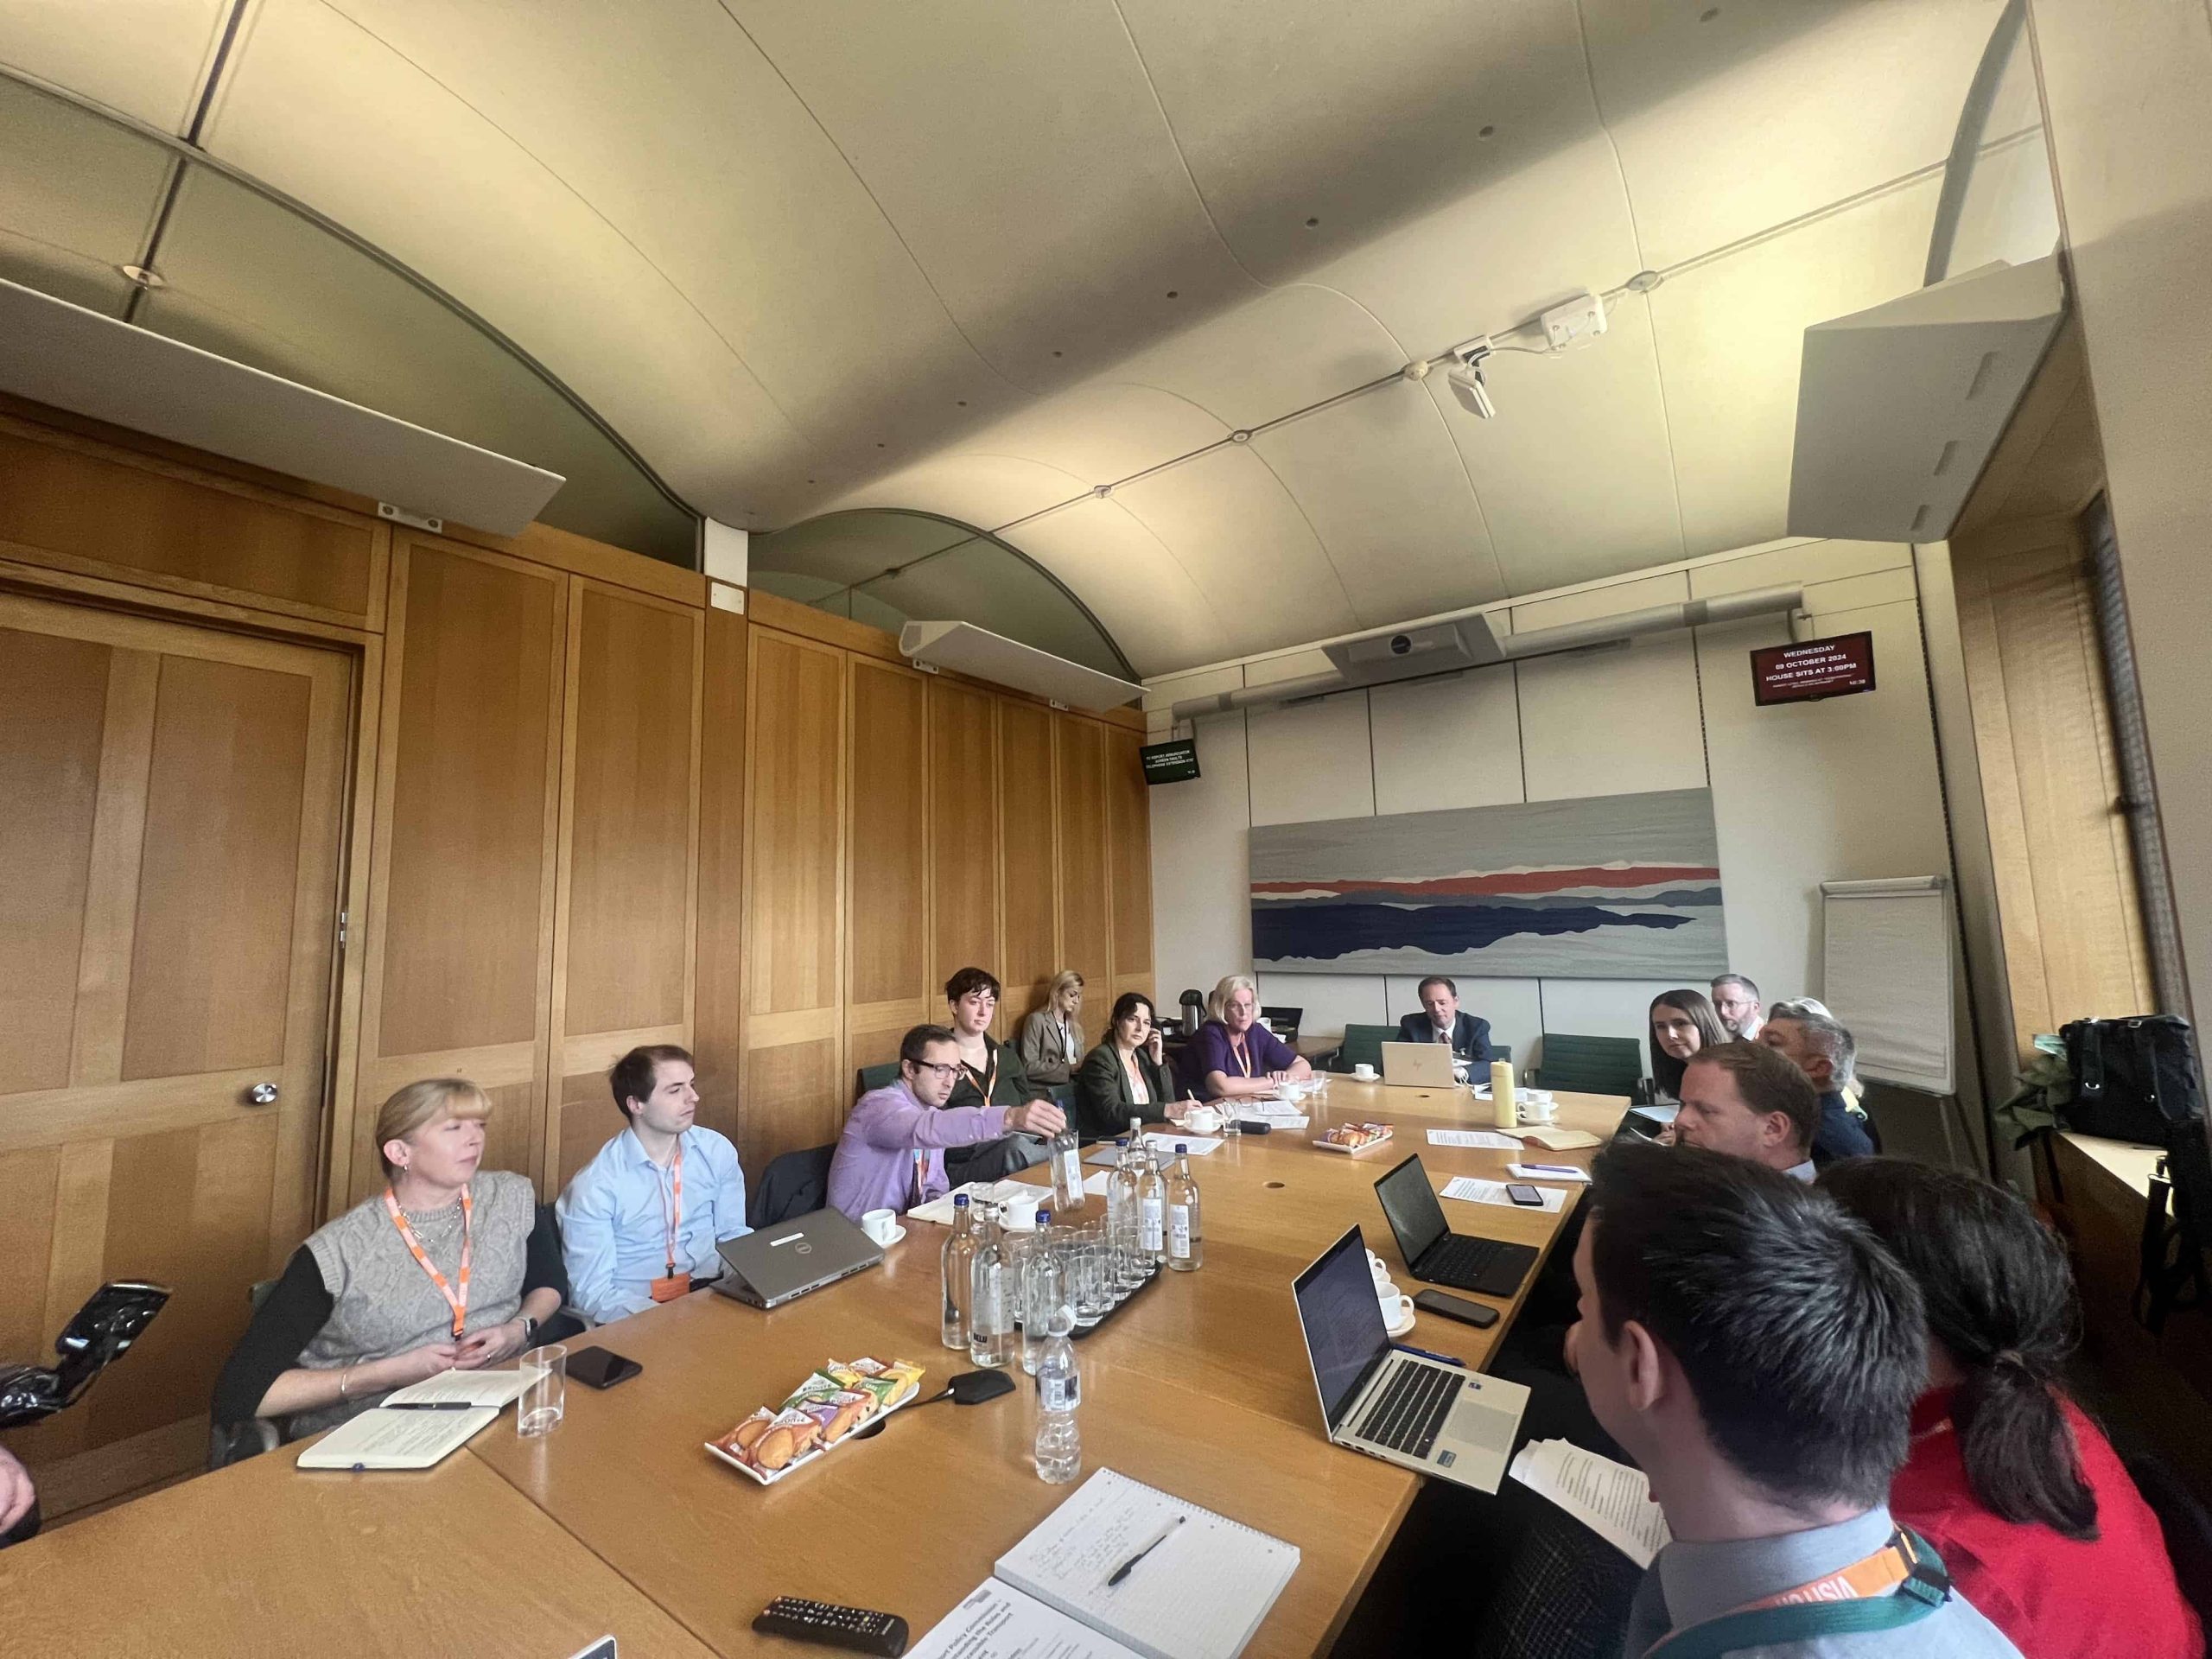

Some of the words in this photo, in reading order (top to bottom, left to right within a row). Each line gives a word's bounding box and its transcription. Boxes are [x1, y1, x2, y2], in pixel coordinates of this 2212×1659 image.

[1783, 645, 1835, 658] WEDNESDAY
[1786, 658, 1826, 668] OCTOBER
[1765, 672, 1795, 682] HOUSE
[1775, 1575, 1859, 1605] VISIT
